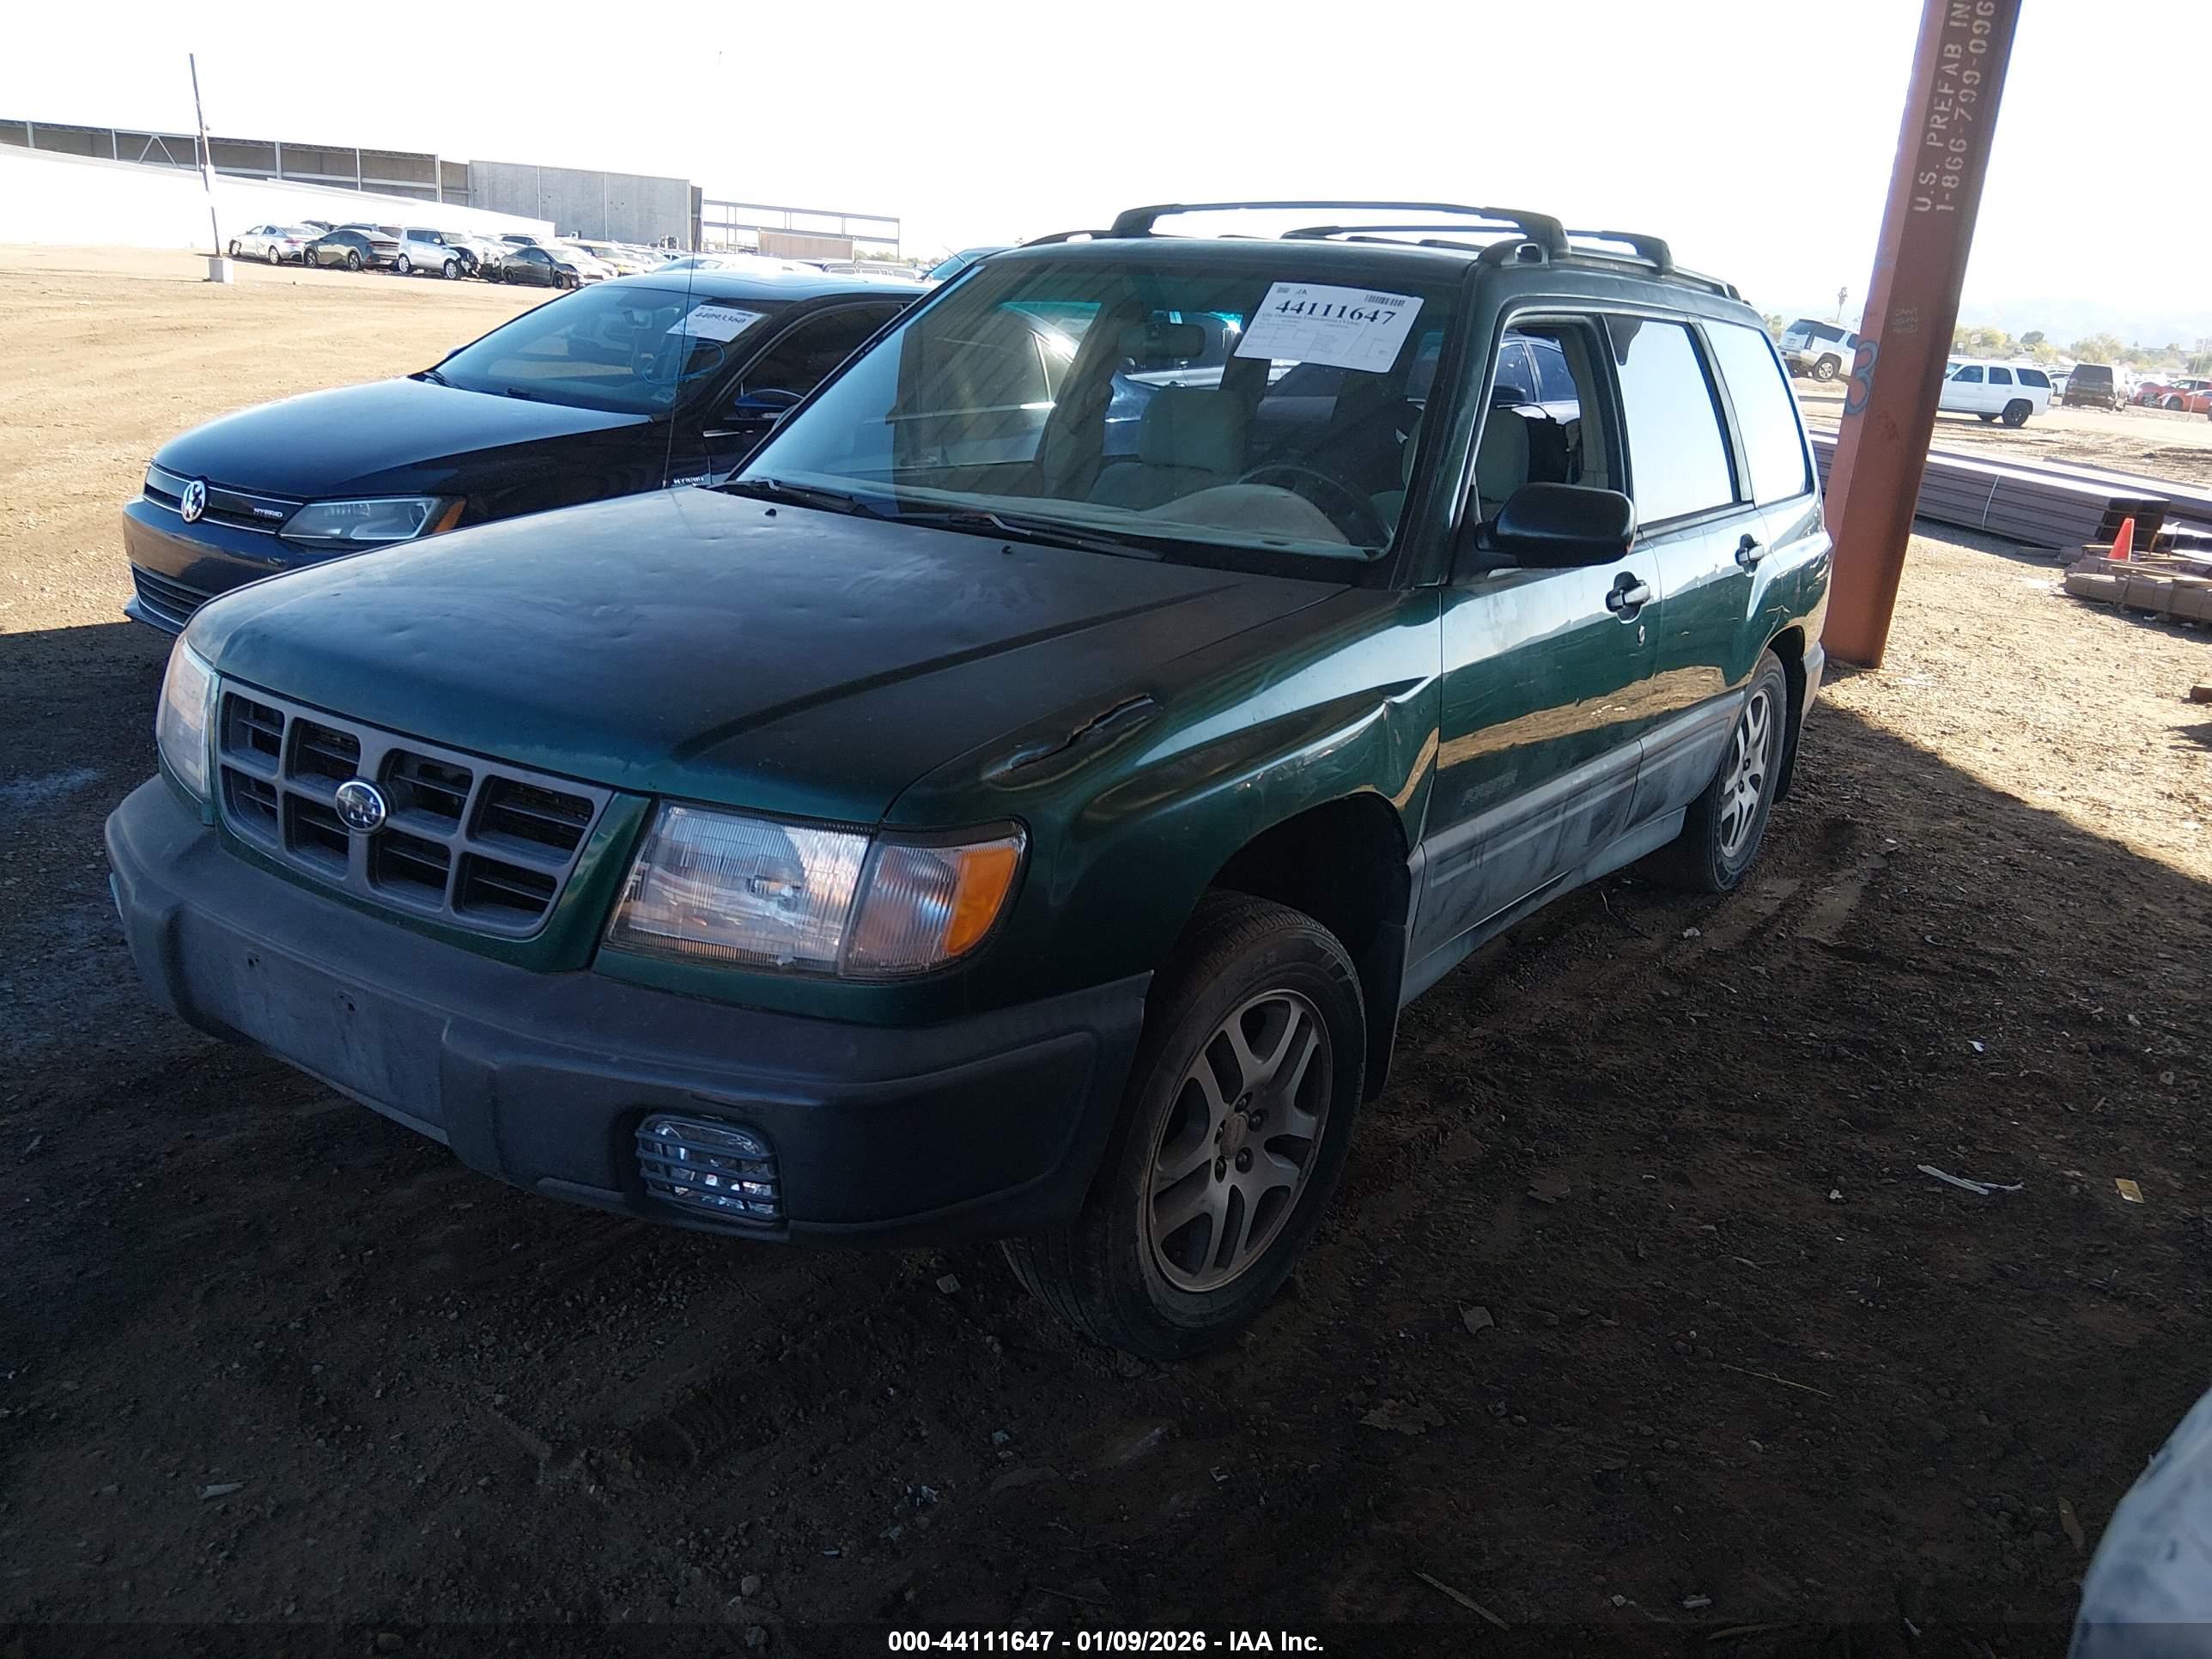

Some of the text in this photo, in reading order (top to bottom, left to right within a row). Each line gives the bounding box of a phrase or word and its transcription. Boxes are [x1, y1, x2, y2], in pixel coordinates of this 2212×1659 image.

[1926, 43, 1962, 148] PREFAB
[1912, 163, 1941, 212] U.S.
[1275, 299, 1398, 325] 44111647
[1844, 339, 1880, 416] 3
[253, 507, 283, 518] HYBRID
